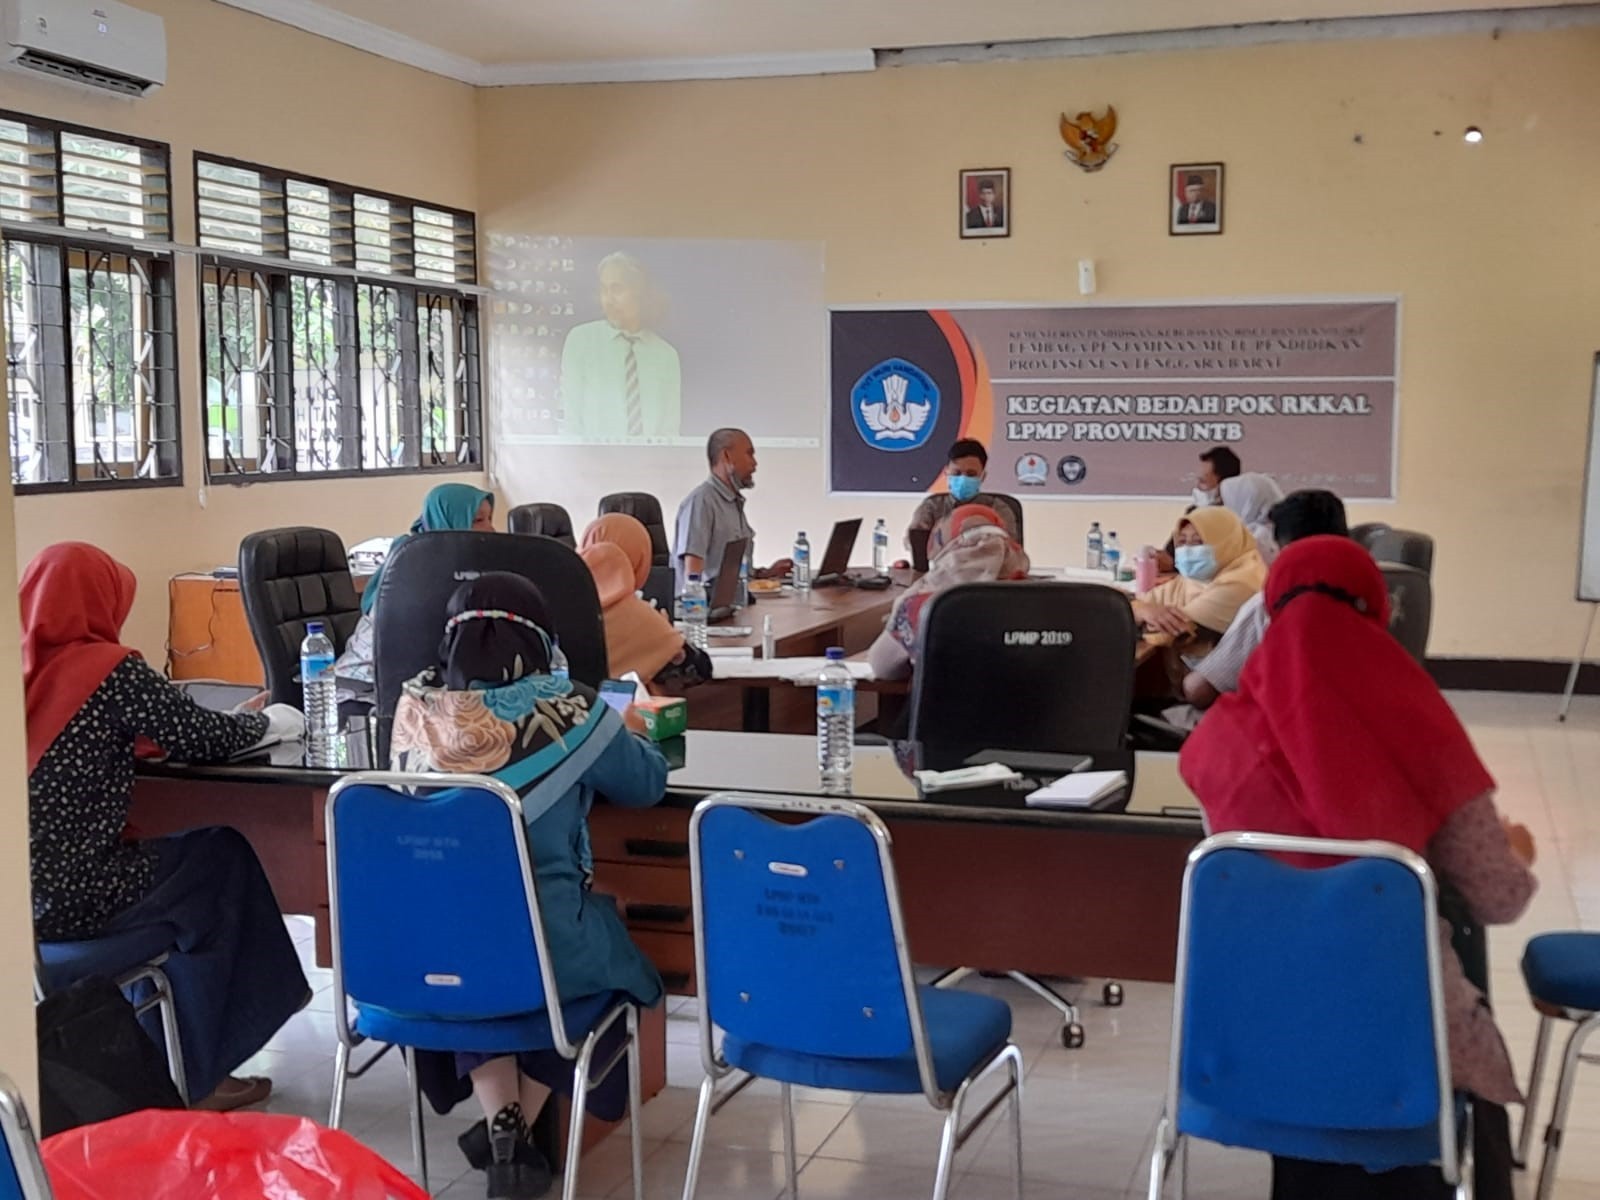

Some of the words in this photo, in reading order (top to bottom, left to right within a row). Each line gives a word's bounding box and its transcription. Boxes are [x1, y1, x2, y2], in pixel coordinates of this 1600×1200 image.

[1007, 395, 1132, 415] KEGIATAN
[1134, 395, 1221, 415] BEDAH
[1224, 395, 1277, 414] POK
[1280, 394, 1371, 414] RKKAL
[1007, 421, 1069, 441] LPMP
[1072, 421, 1188, 441] PROVINSI
[1190, 421, 1243, 441] NTB
[1003, 631, 1041, 645] LPMP
[1040, 630, 1073, 645] 2019
